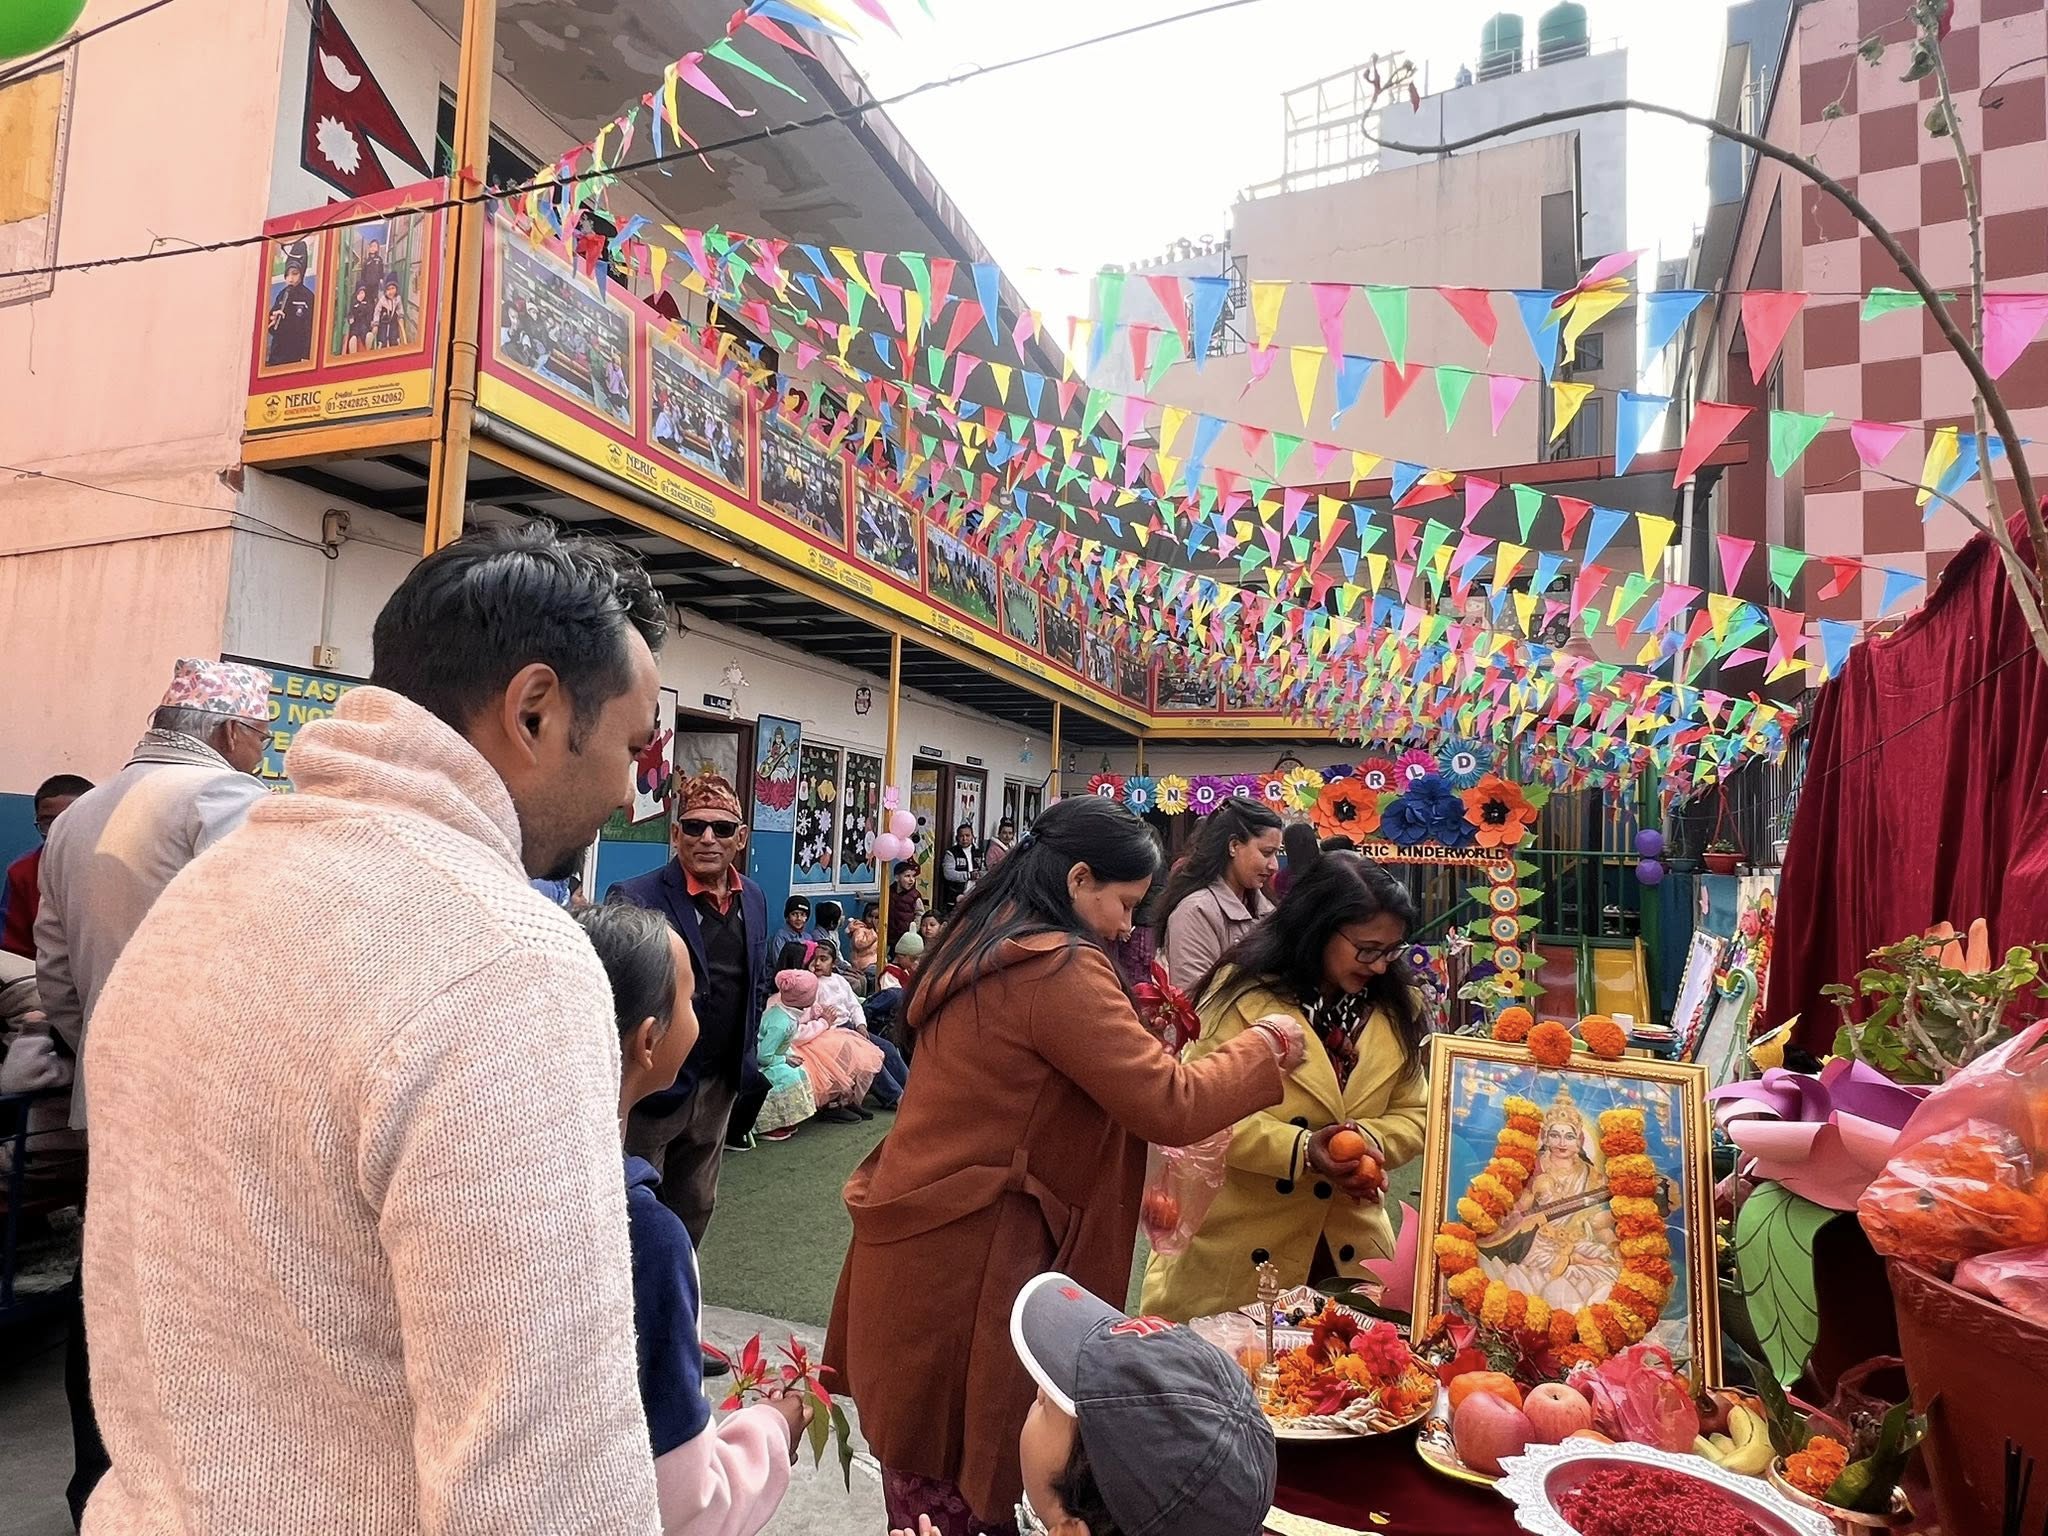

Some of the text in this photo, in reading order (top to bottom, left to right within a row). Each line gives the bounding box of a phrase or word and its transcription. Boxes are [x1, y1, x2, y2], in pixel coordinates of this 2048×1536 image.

[285, 391, 321, 408] NERIC
[625, 453, 657, 479] NERIC
[1396, 845, 1506, 860] KINDERWORLD
